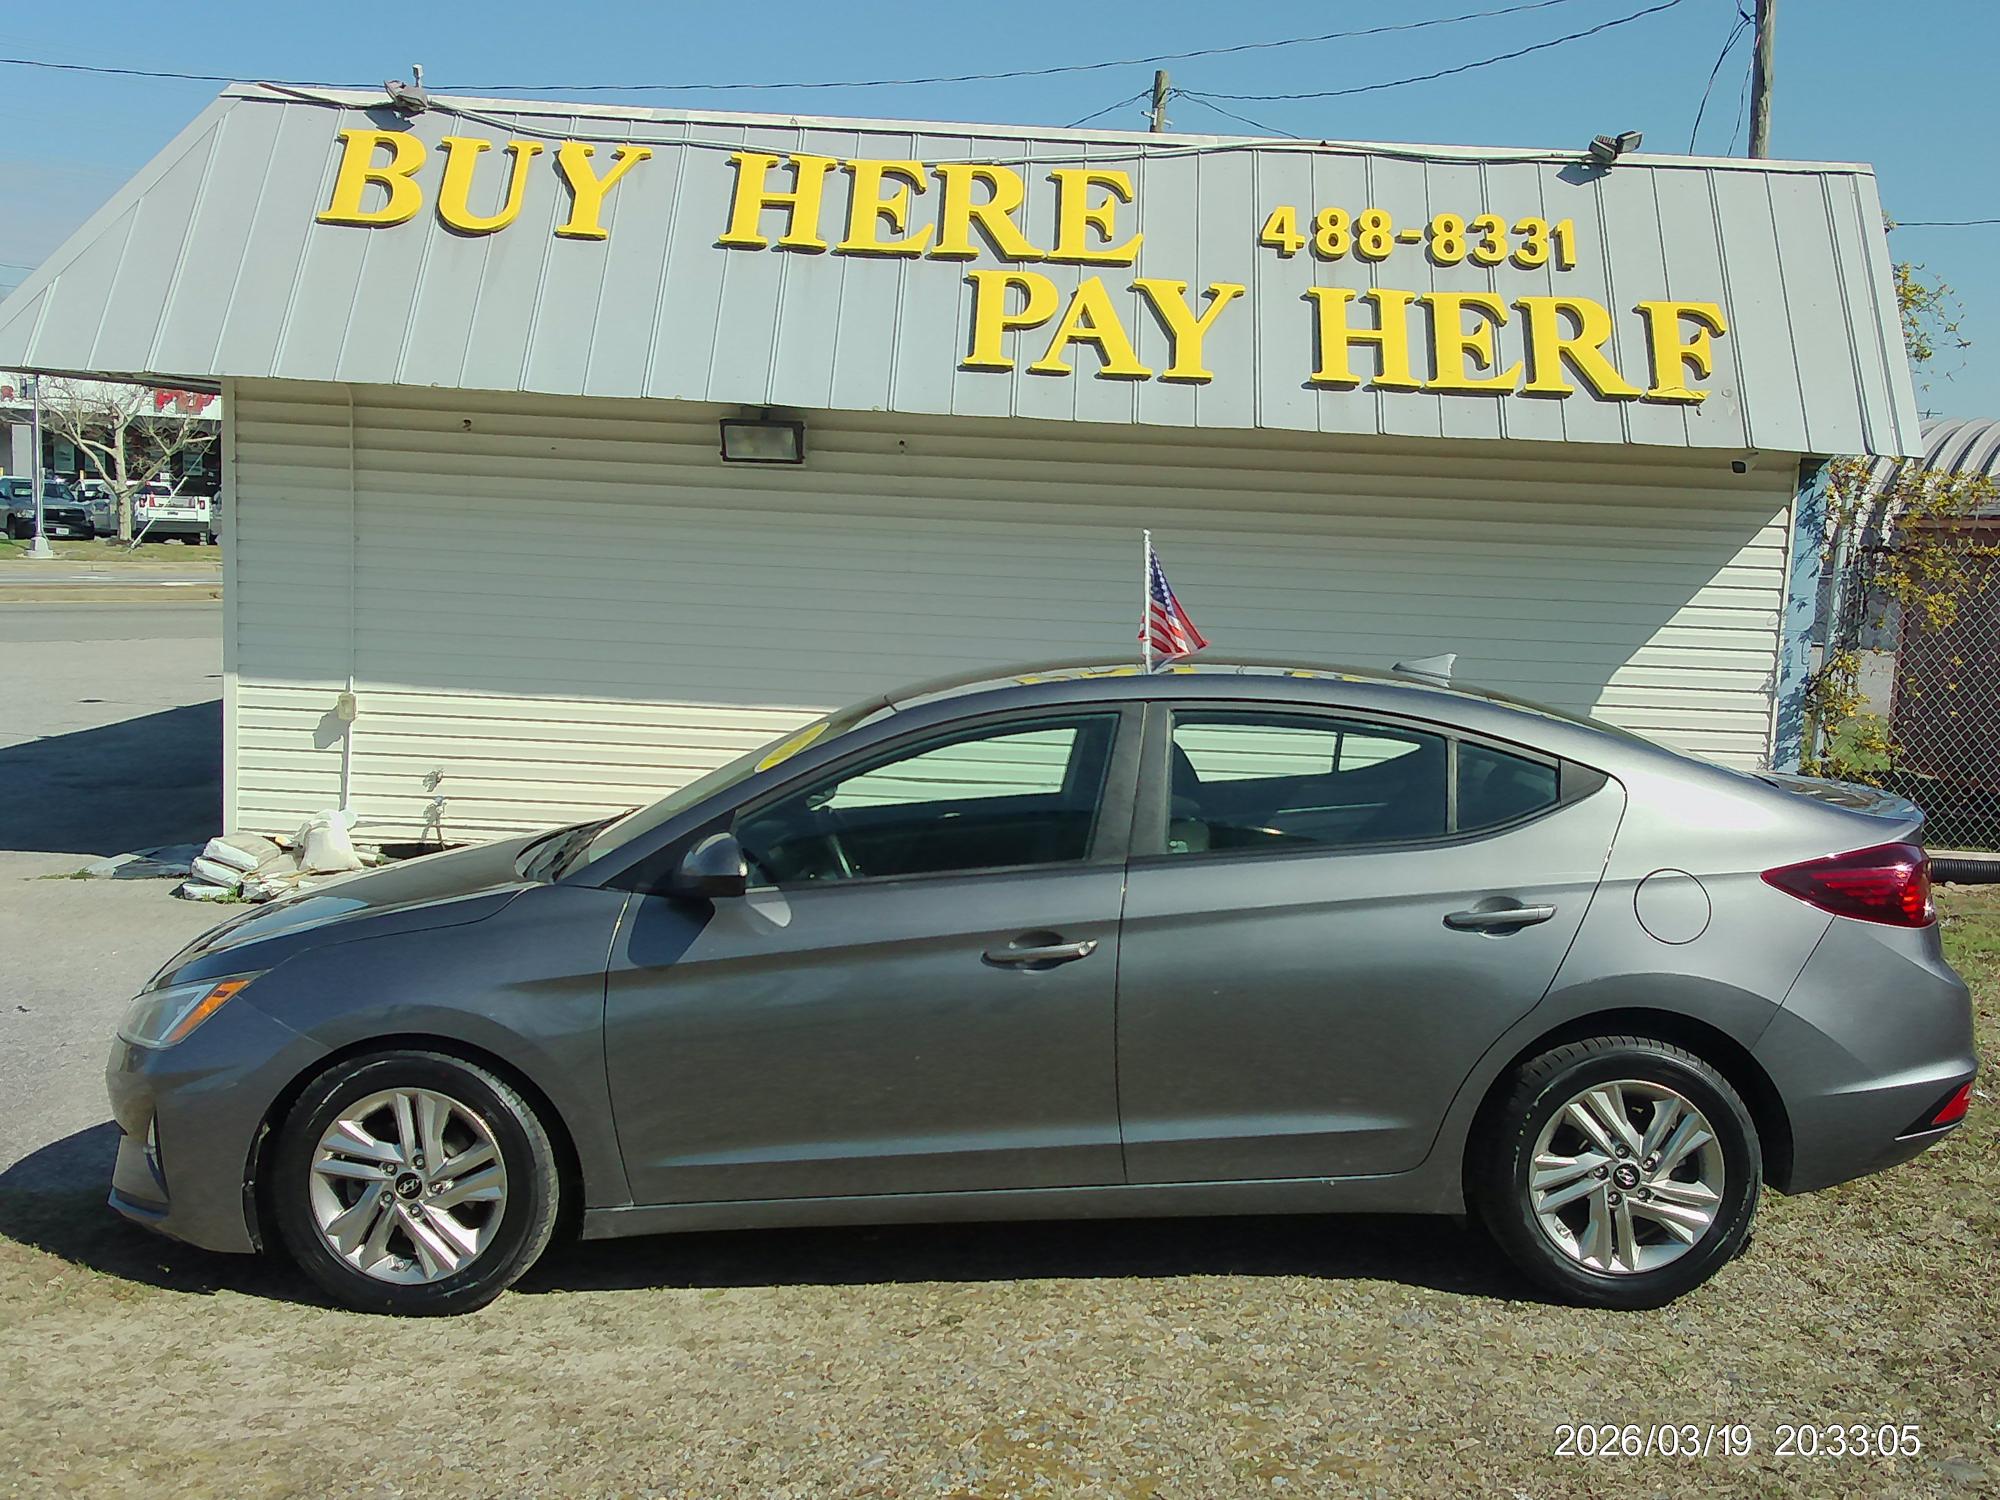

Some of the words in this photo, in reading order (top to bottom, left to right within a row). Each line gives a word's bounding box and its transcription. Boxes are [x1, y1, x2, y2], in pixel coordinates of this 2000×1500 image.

[316, 129, 652, 240] BUY
[718, 151, 1144, 264] HERE
[1260, 205, 1576, 266] 488-8331
[962, 270, 1245, 381] PAY
